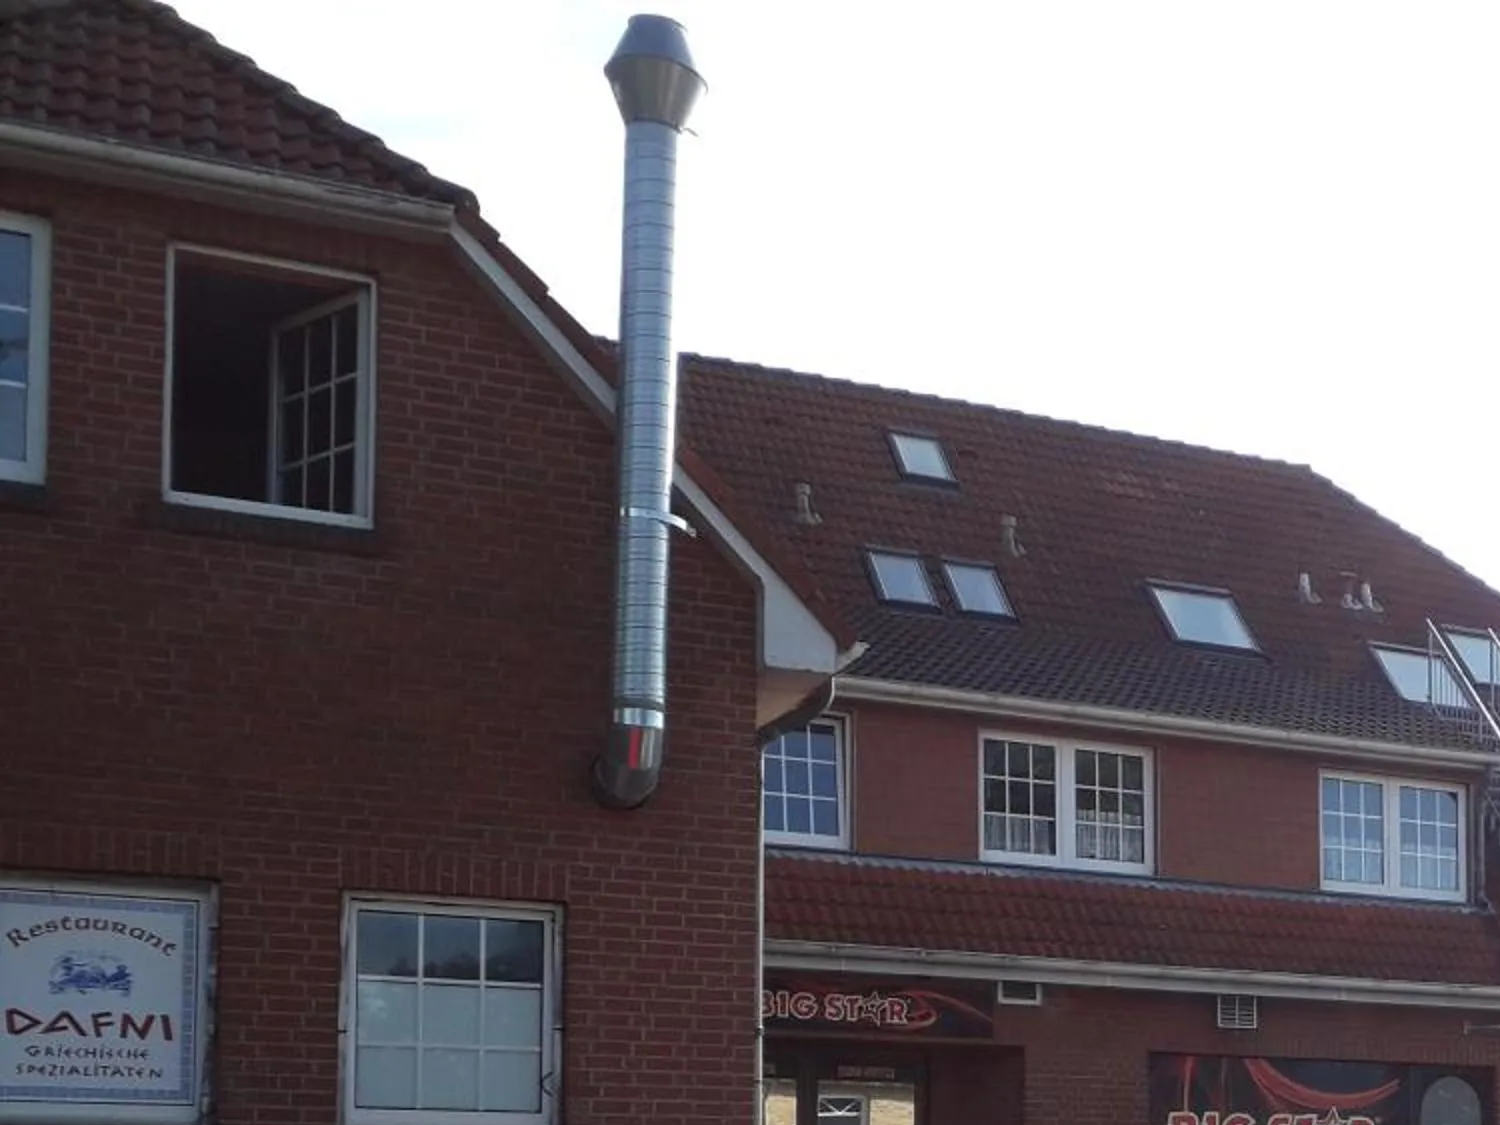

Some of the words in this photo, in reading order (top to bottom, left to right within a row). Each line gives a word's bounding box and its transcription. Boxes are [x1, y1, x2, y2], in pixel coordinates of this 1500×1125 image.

[5, 915, 177, 957] Restaurant
[762, 989, 819, 1020] BIG
[5, 1007, 173, 1041] DAFNI
